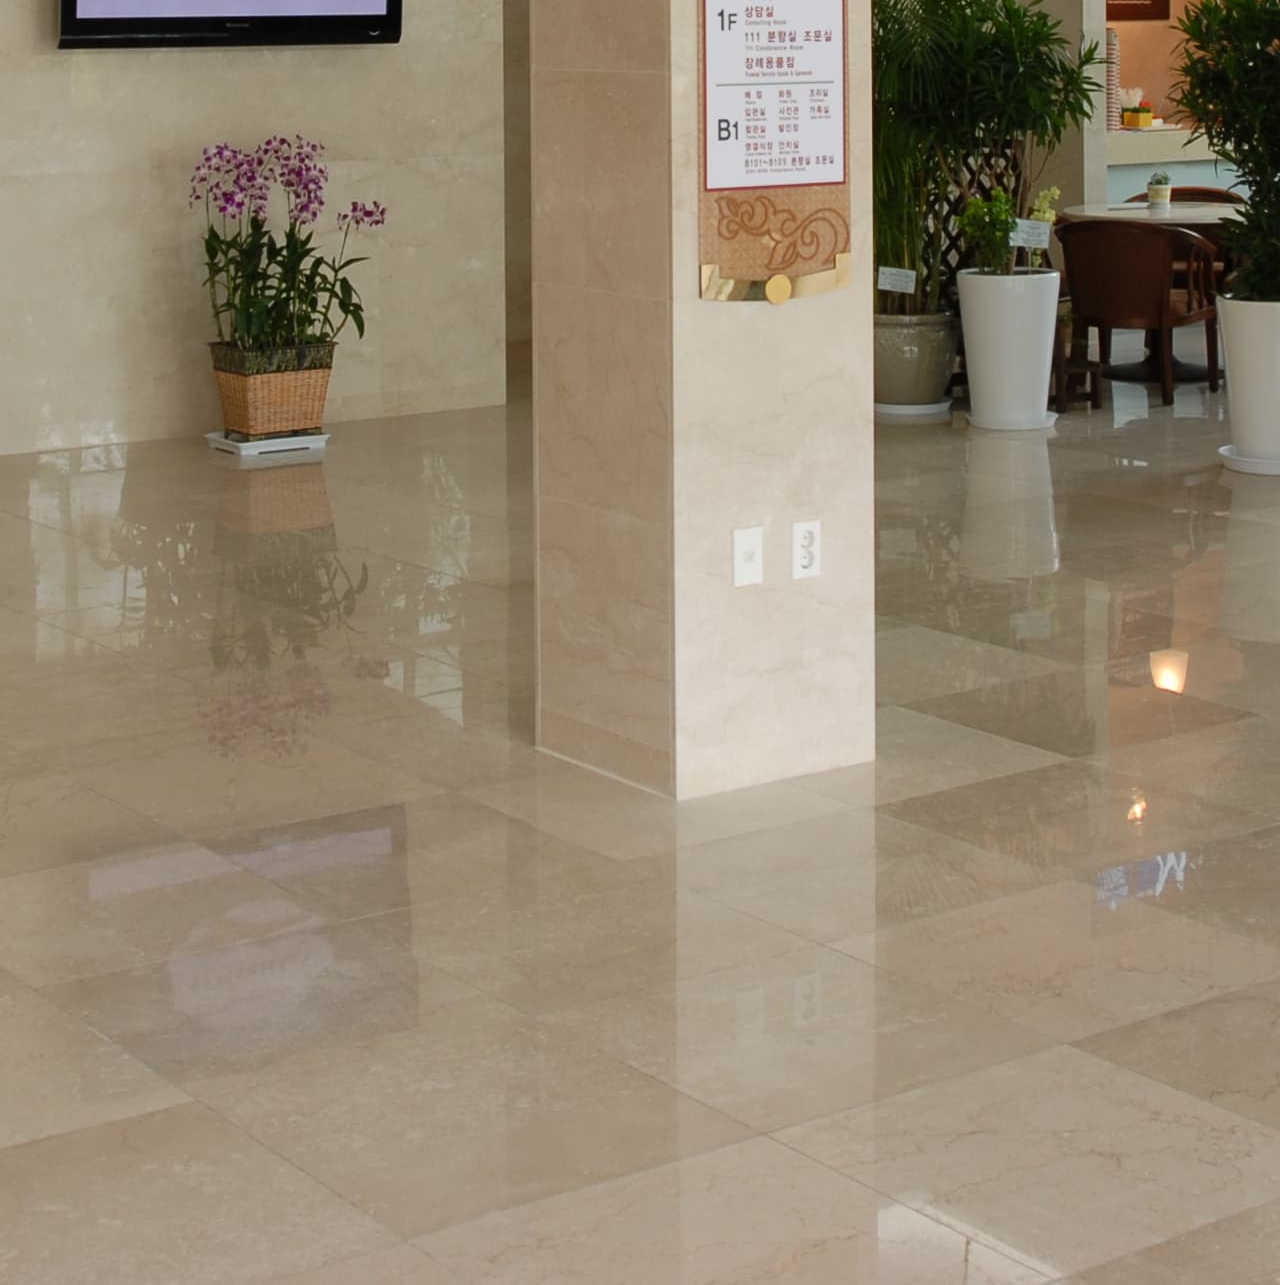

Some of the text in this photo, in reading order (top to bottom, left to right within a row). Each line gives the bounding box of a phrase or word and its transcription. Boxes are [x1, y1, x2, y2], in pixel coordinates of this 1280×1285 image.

[744, 5, 774, 19] 상담실
[717, 9, 738, 32] 1F
[744, 32, 760, 43] 111
[803, 29, 833, 43] 조문실
[744, 56, 796, 69] 장례용품점
[717, 118, 739, 141] B1
